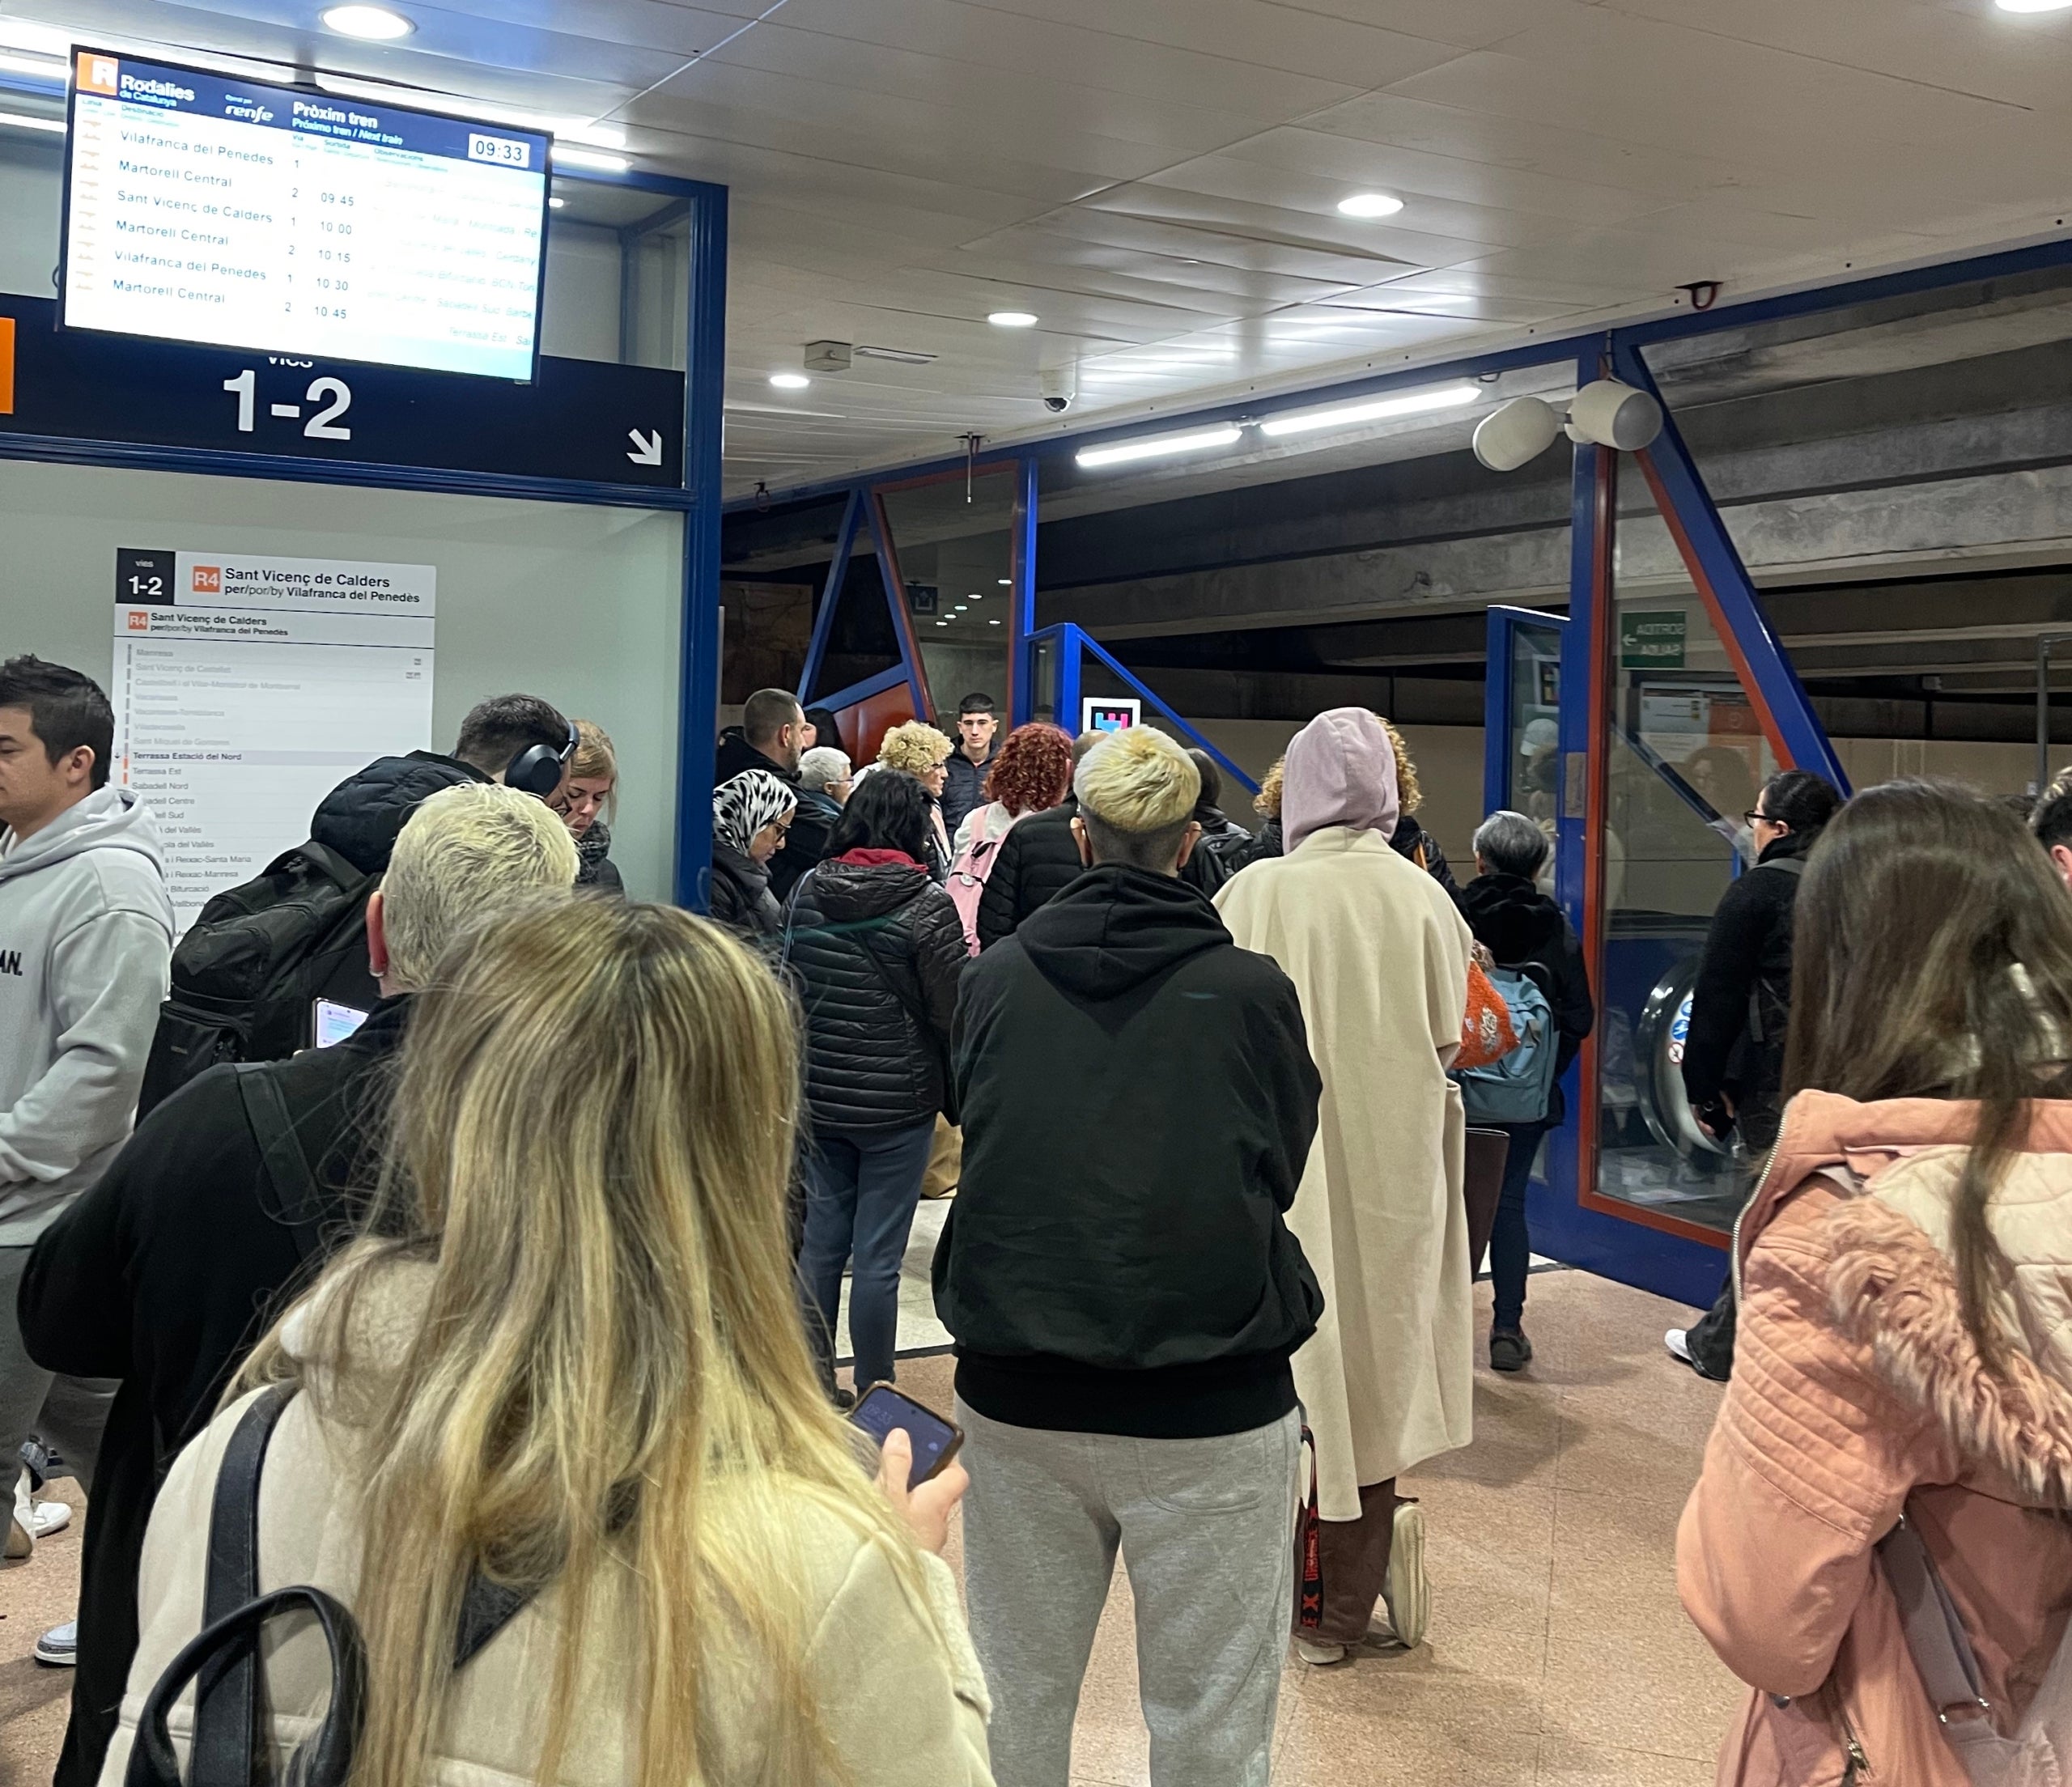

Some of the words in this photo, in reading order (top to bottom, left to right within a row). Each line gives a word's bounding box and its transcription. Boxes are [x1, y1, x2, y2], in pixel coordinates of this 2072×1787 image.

[121, 74, 195, 101] Rodalies
[225, 105, 274, 123] renfe
[293, 101, 346, 123] Pròxim
[349, 113, 378, 129] tren
[292, 117, 331, 133] Próximo
[357, 129, 381, 142] Next
[382, 134, 403, 146] train
[121, 130, 189, 151] Vilafranca
[193, 144, 213, 155] del
[295, 159, 299, 168] 1
[475, 140, 523, 161] 09:33
[119, 159, 179, 179] Martorell
[184, 171, 231, 188] Central
[292, 188, 299, 198] 2
[117, 190, 148, 205] Sant
[202, 205, 219, 215] de
[223, 206, 273, 223] Calders
[291, 217, 296, 227] 1
[116, 220, 176, 238] Martorell
[180, 230, 228, 246] Central
[288, 245, 295, 255] 2
[114, 250, 182, 269] Vilafranca
[186, 261, 206, 272] del
[287, 274, 292, 284] 1
[113, 279, 172, 297] Martorell
[178, 288, 225, 303] Central
[285, 302, 291, 312] 2
[223, 369, 351, 441] 1-2
[129, 575, 163, 596] 1-2
[194, 570, 219, 588] R4
[224, 568, 258, 580] Sant
[262, 569, 310, 584] Vicenç
[314, 573, 333, 584] de
[337, 574, 390, 588] Calders
[224, 584, 284, 597] per/por/by
[287, 586, 346, 601] Vilafranca
[349, 588, 368, 601] del
[370, 591, 420, 603] Penedès
[130, 614, 147, 626] R4
[151, 613, 176, 622] Sant
[176, 613, 210, 626] Vicenç
[213, 616, 227, 624] de
[228, 616, 267, 626] Calders
[194, 625, 236, 635] Vilafranca
[133, 752, 170, 760] Terrassa
[172, 752, 204, 760] Estació
[221, 753, 242, 761] Nord
[132, 782, 168, 790] Sabadell
[177, 840, 190, 848] del
